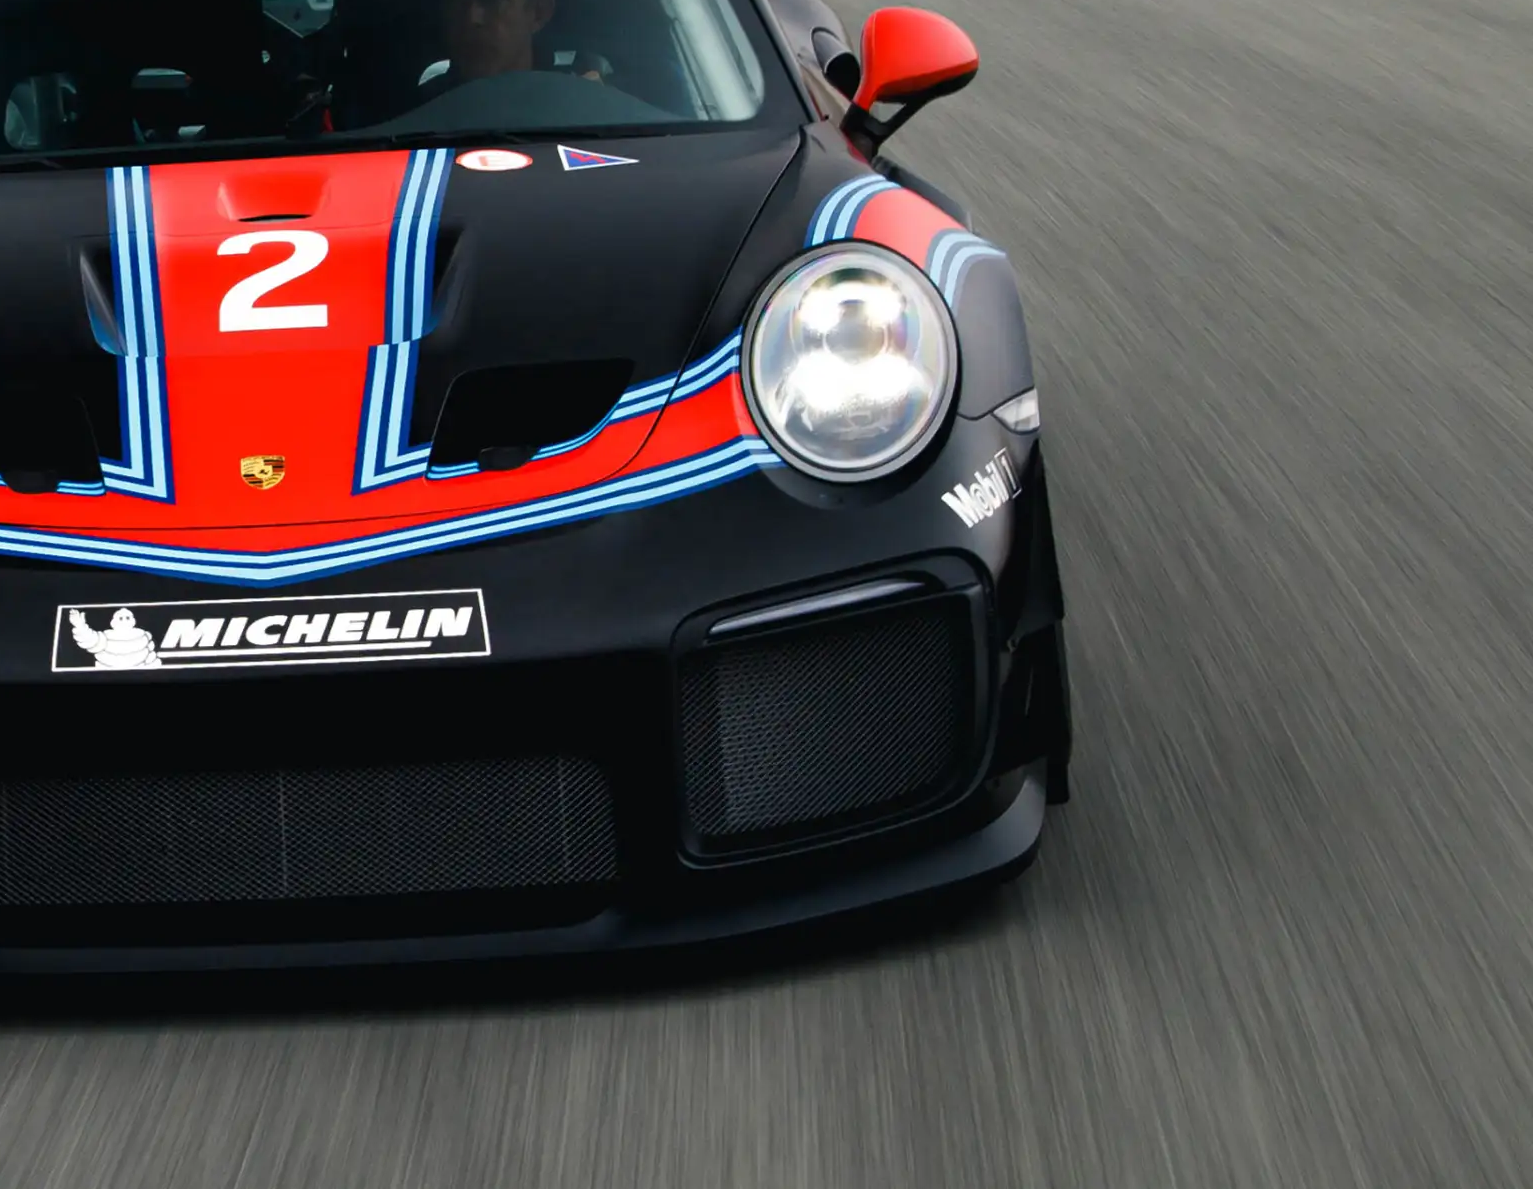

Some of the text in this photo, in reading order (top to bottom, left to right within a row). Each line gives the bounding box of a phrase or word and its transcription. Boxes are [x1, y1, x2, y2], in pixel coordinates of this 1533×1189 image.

[217, 230, 329, 332] 2
[941, 454, 1017, 528] Mobil 1
[161, 606, 473, 649] MICHELIN
